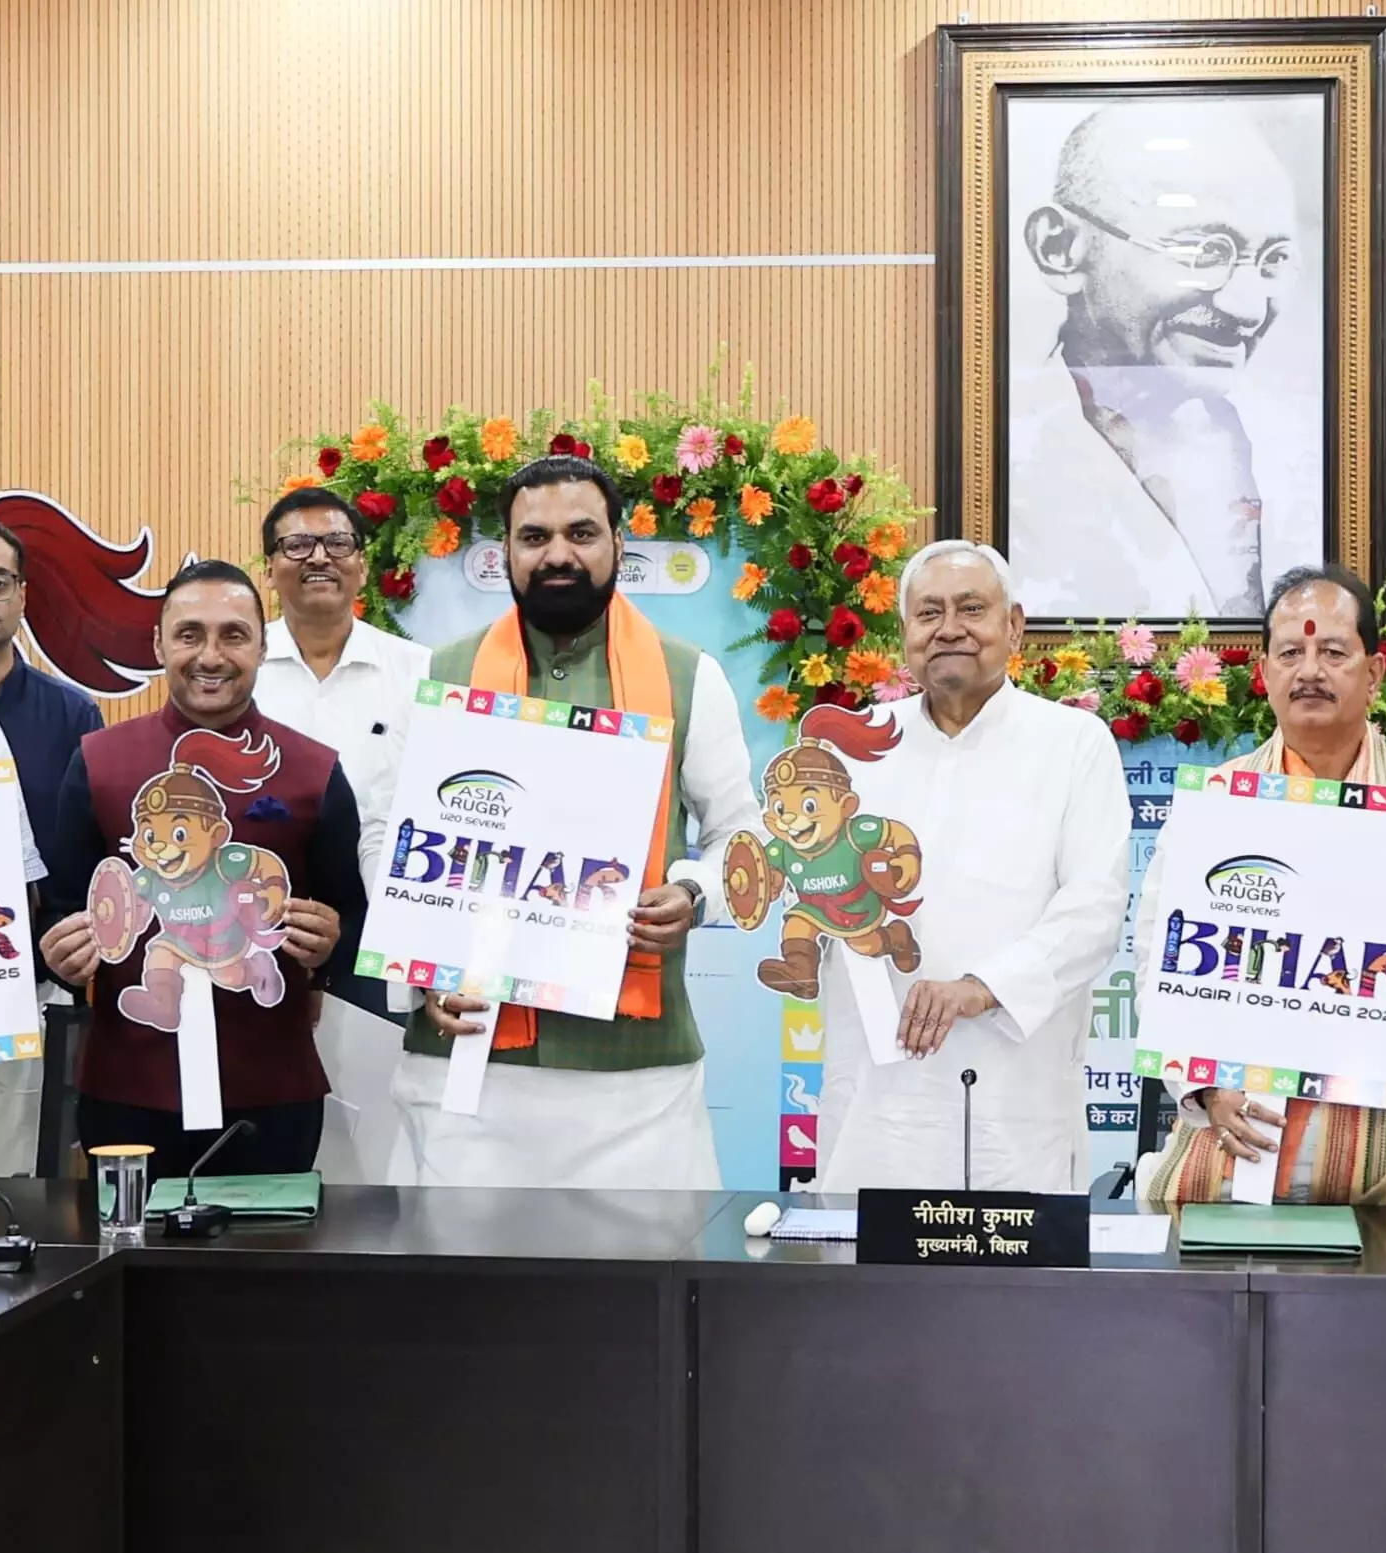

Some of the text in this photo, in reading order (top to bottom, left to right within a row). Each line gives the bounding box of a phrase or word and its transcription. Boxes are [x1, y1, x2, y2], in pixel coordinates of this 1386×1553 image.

[458, 785, 506, 803] ASIA
[450, 796, 513, 819] RUGBY
[440, 812, 506, 831] U20 SEVENS
[388, 817, 631, 912] BIHAR
[803, 874, 849, 890] ASHOKA
[1227, 871, 1278, 889] ASIA
[1220, 884, 1285, 904] RUGBY
[169, 905, 213, 920] ASHOKA
[385, 886, 454, 909] RAJGIR
[525, 911, 566, 928] AUG
[1210, 901, 1281, 918] U20 SEVENS
[1157, 981, 1231, 1002] RAJGIR
[1246, 993, 1301, 1011] 09-10
[1309, 1001, 1351, 1017] AUG
[912, 1200, 1035, 1233] नीतीश कुमार
